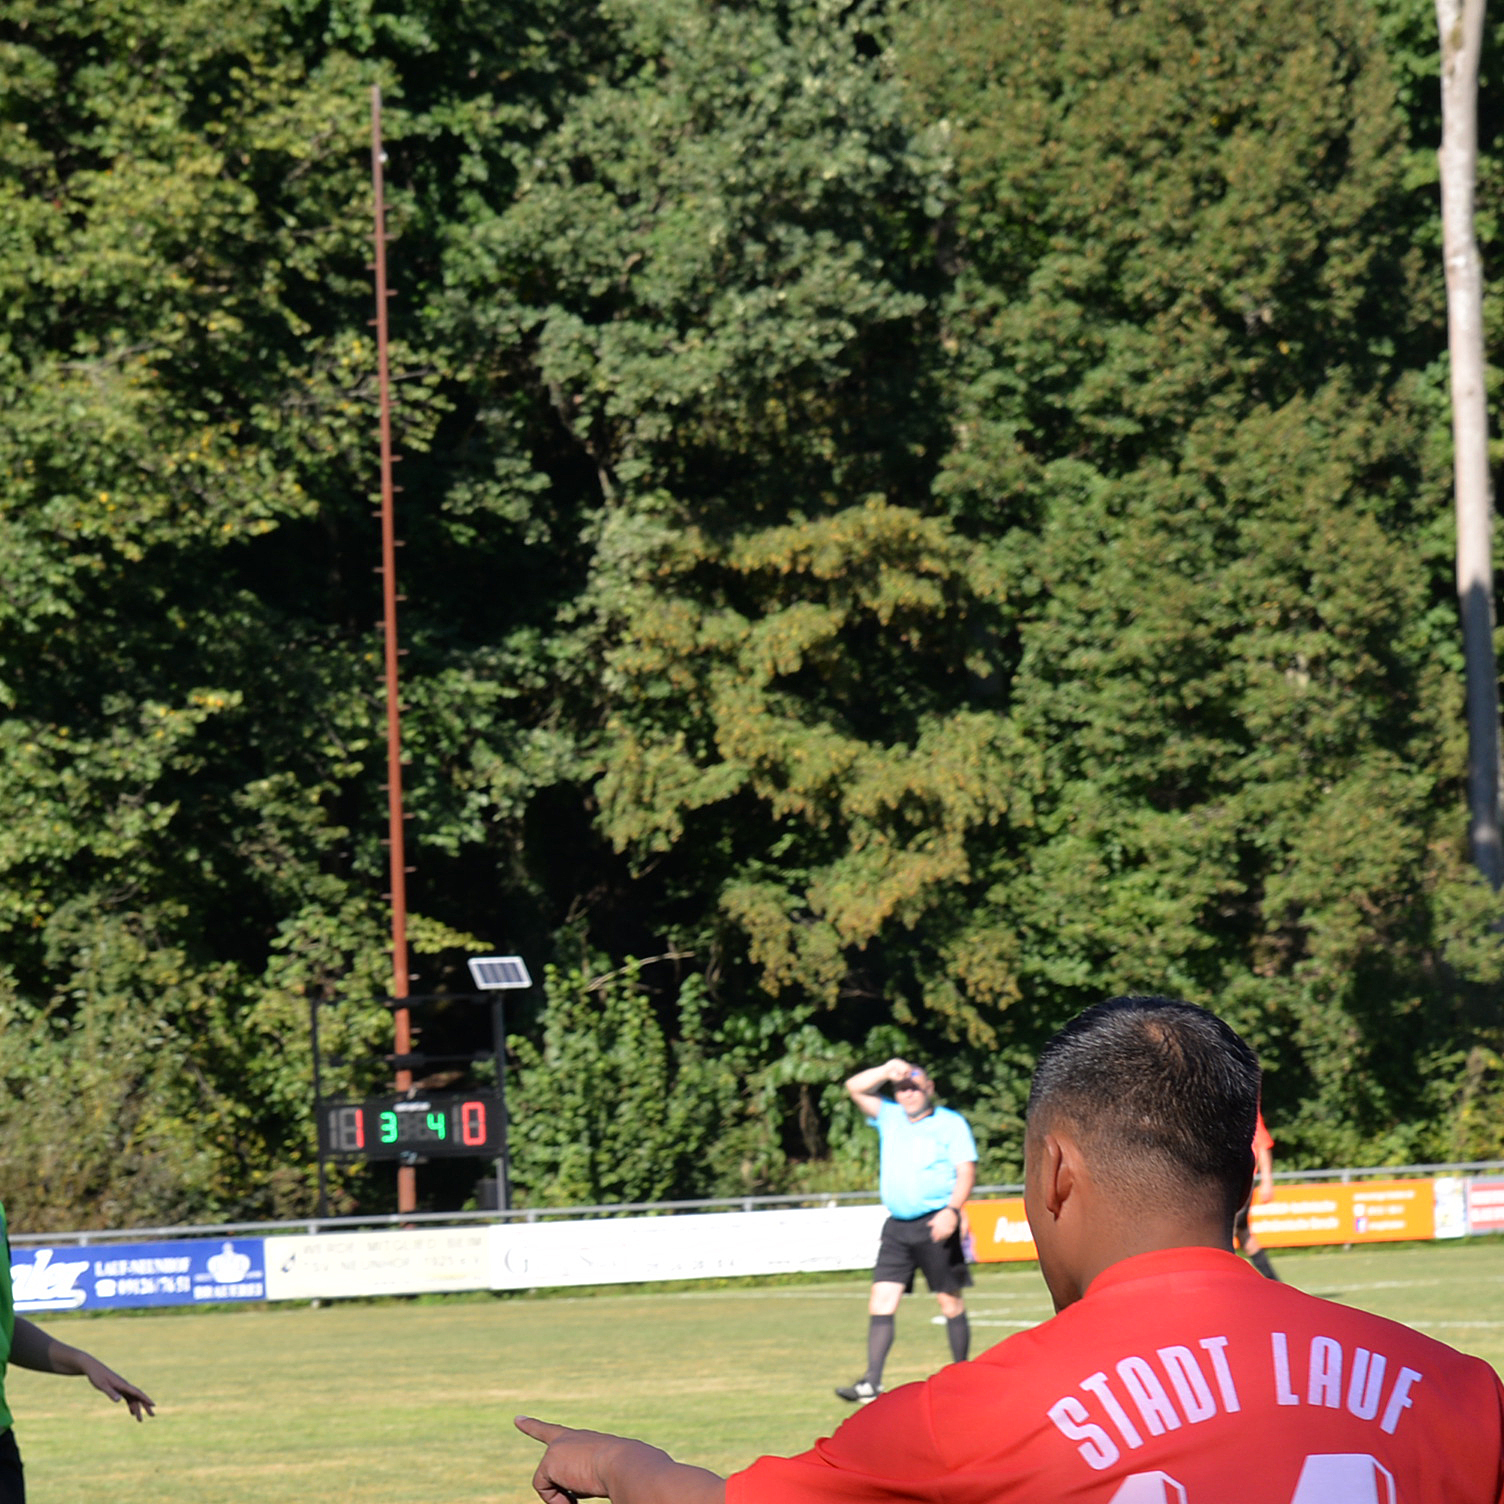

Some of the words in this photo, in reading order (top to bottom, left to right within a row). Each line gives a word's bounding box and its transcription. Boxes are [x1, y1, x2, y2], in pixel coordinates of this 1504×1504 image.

[379, 1111, 398, 1143] 3
[426, 1112, 446, 1140] 4
[461, 1101, 486, 1146] 0
[1046, 1334, 1241, 1470] STADT
[1272, 1331, 1423, 1435] LAUF
